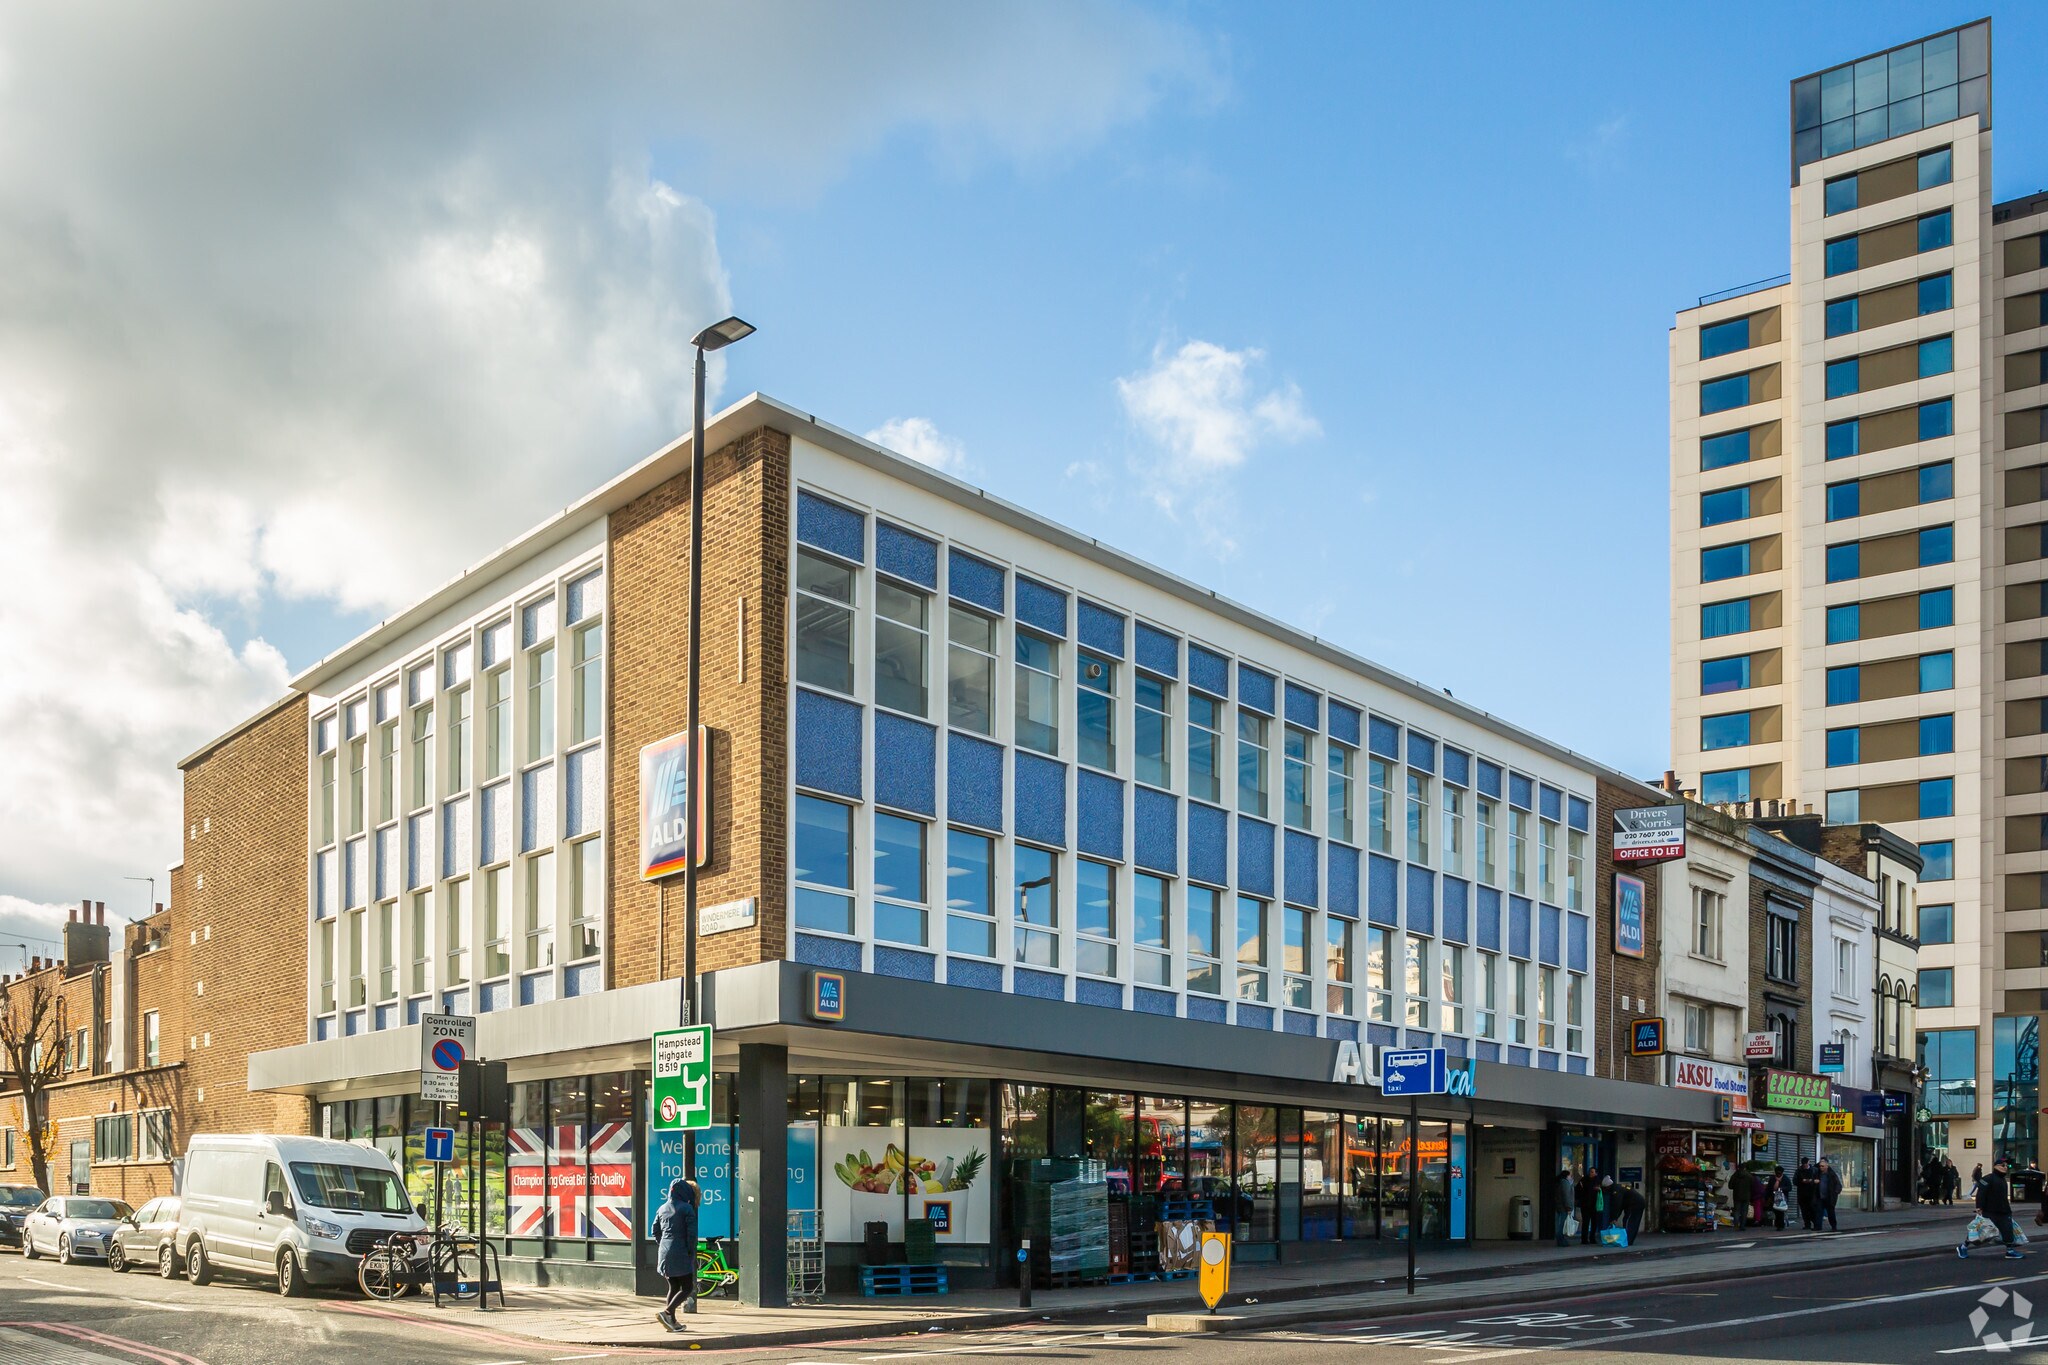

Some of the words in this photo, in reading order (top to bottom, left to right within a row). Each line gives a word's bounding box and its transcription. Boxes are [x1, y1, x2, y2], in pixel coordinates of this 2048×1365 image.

[1630, 809, 1668, 819] Drivers
[650, 817, 687, 848] ALD
[1620, 849, 1649, 858] OFFICE
[1651, 848, 1664, 857] TO
[1666, 846, 1680, 855] LET
[701, 921, 719, 933] ROAD
[1620, 923, 1640, 941] ALDI
[820, 999, 839, 1009] ALDI
[426, 1016, 472, 1028] Controlled
[433, 1027, 465, 1038] ZONE
[658, 1036, 701, 1049] Hampstead
[1637, 1040, 1657, 1048] ALDI
[658, 1049, 693, 1062] Highgate
[658, 1063, 664, 1073] B
[665, 1062, 678, 1072] 519
[1332, 1039, 1402, 1087] AL
[1677, 1062, 1713, 1087] AKSU
[1714, 1078, 1730, 1091] Food
[1730, 1080, 1747, 1093] Store
[1769, 1073, 1828, 1097] EXPRESS
[1785, 1098, 1811, 1106] STOP
[660, 1139, 731, 1156] Weome
[1659, 1146, 1688, 1154] OPEN
[660, 1162, 708, 1179] hoe
[714, 1163, 731, 1179] of
[558, 1174, 576, 1186] Great
[600, 1172, 626, 1189] Quality
[934, 1220, 948, 1228] LDI
[1457, 1312, 1677, 1330] BUS
